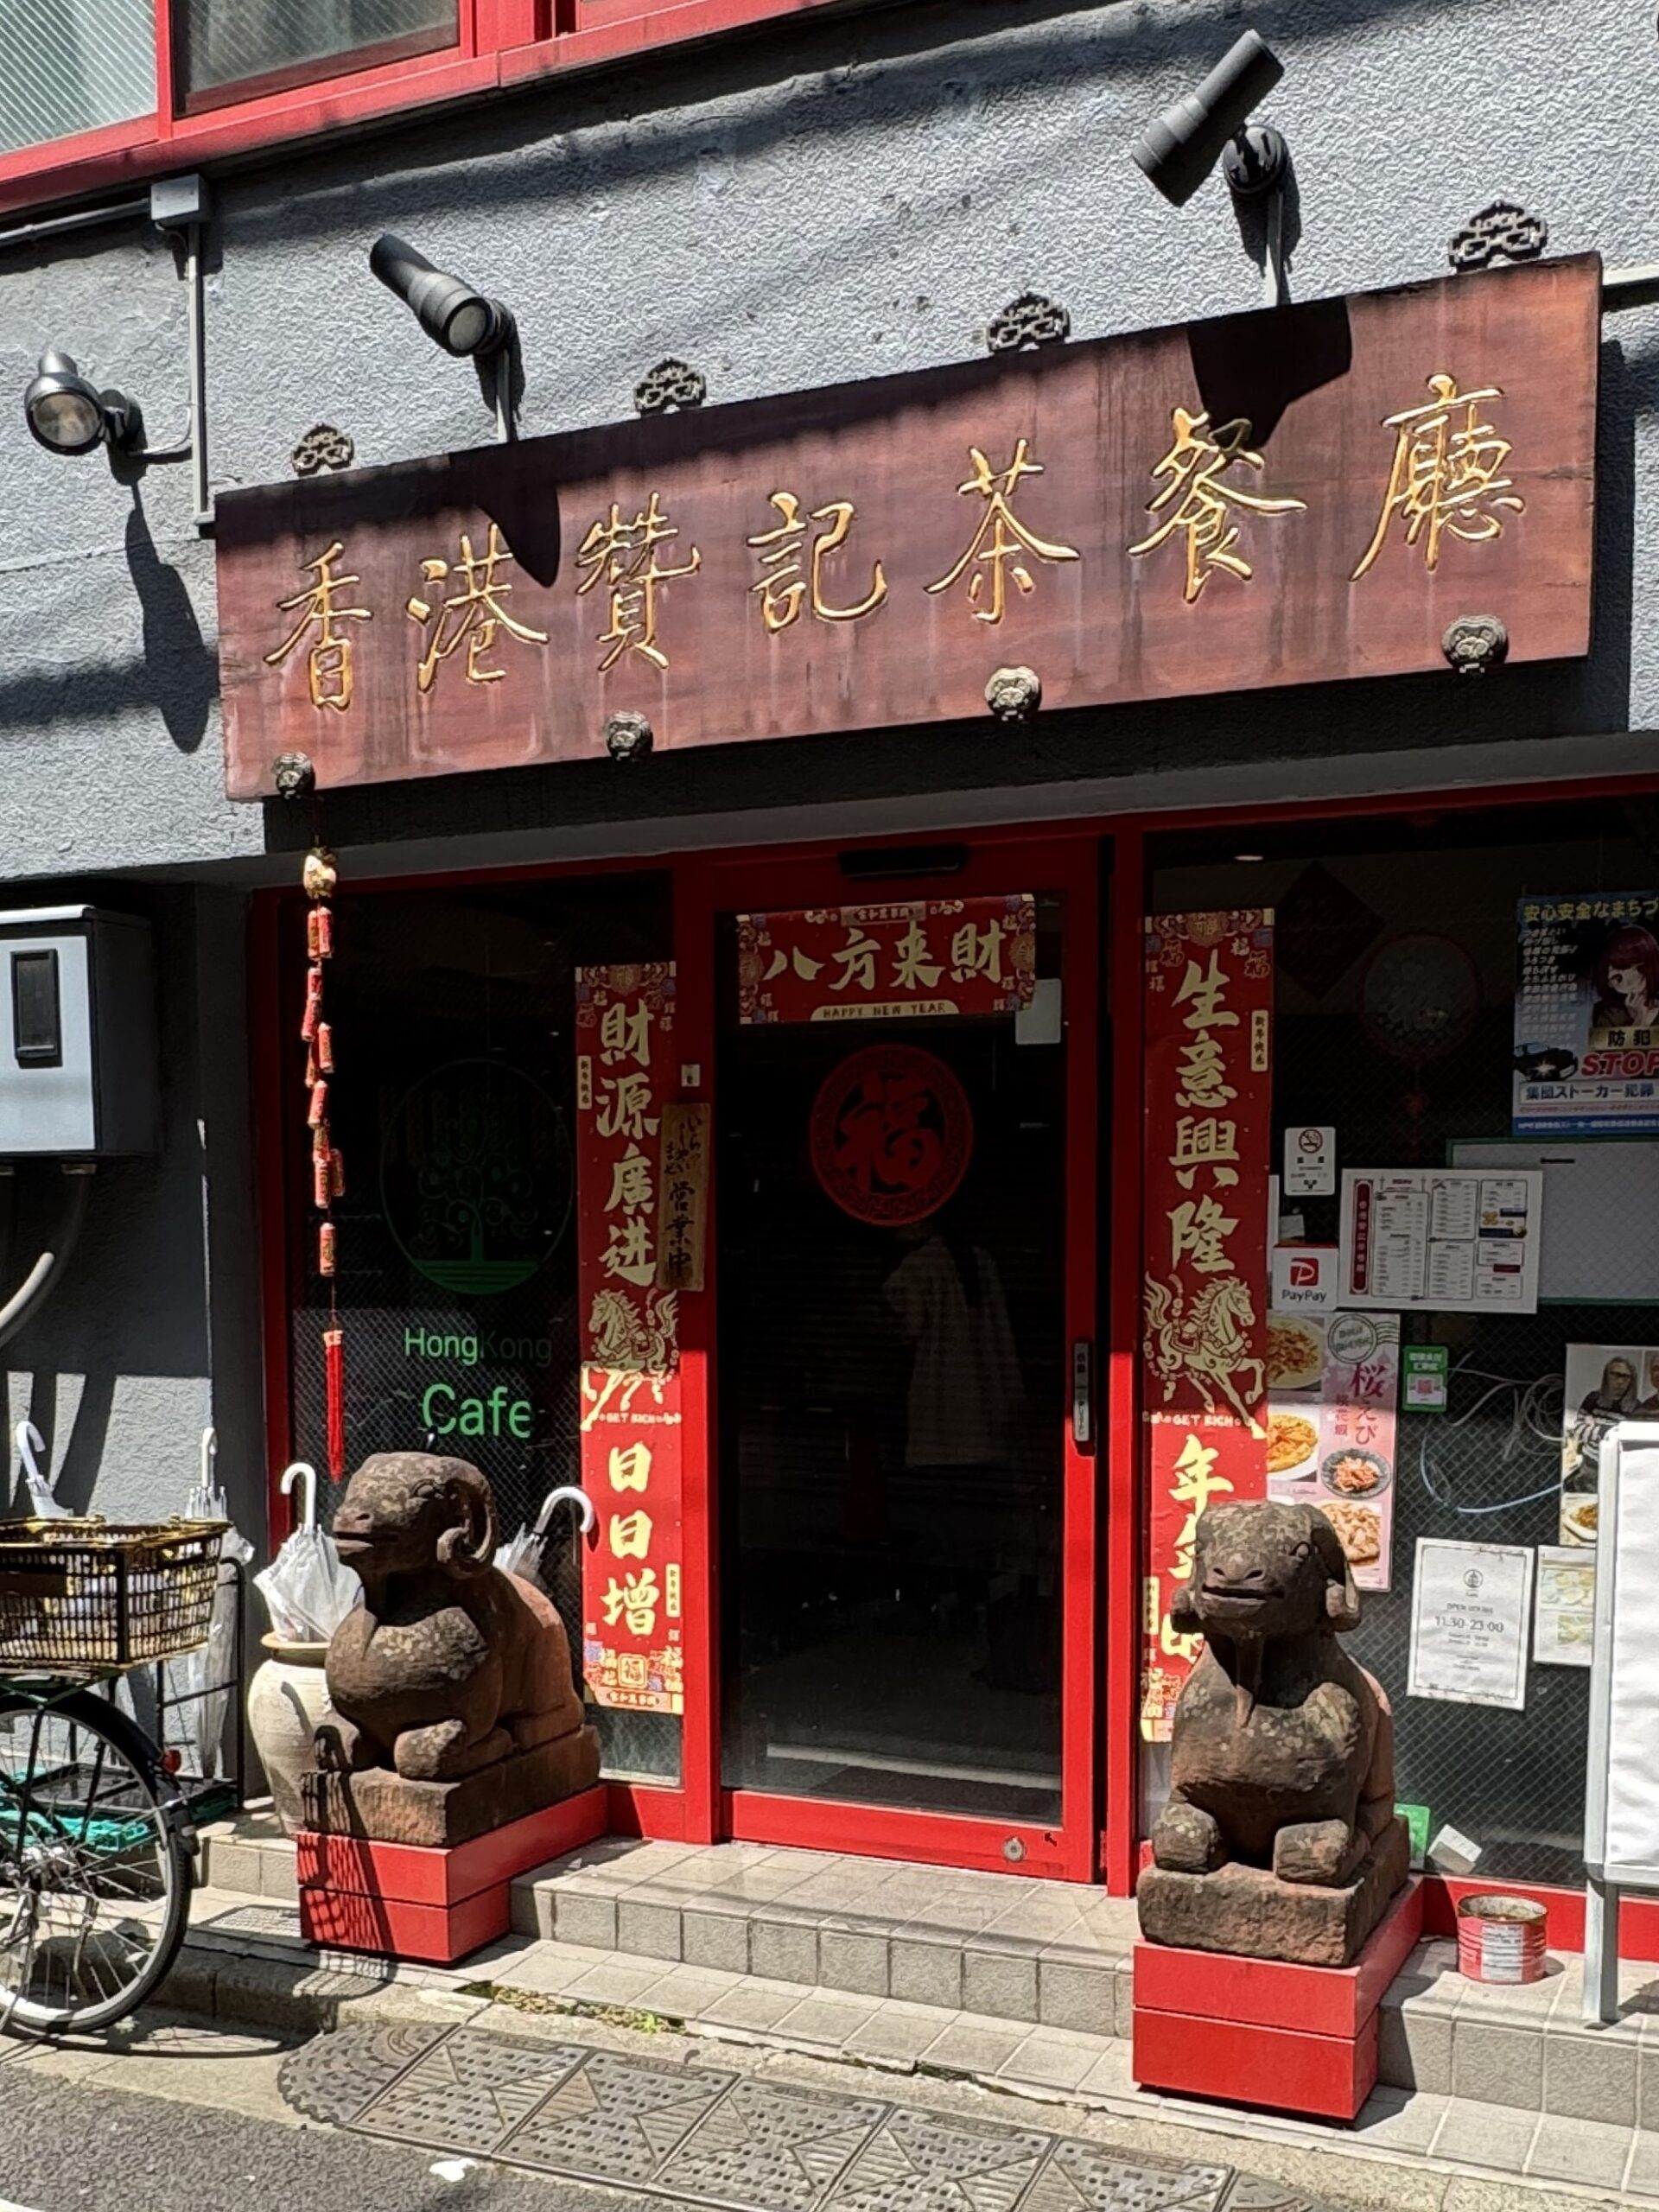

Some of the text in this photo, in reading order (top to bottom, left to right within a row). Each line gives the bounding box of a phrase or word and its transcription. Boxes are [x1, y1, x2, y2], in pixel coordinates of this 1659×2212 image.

[823, 1002, 945, 1018] HAPPY NEW YEAR
[1166, 950, 1240, 1274] 生意興隆
[1281, 1289, 1326, 1303] PayPay
[404, 1327, 552, 1368] Hong Kong
[422, 1383, 531, 1439] Cafe
[1173, 1414, 1233, 1427] GET RICH
